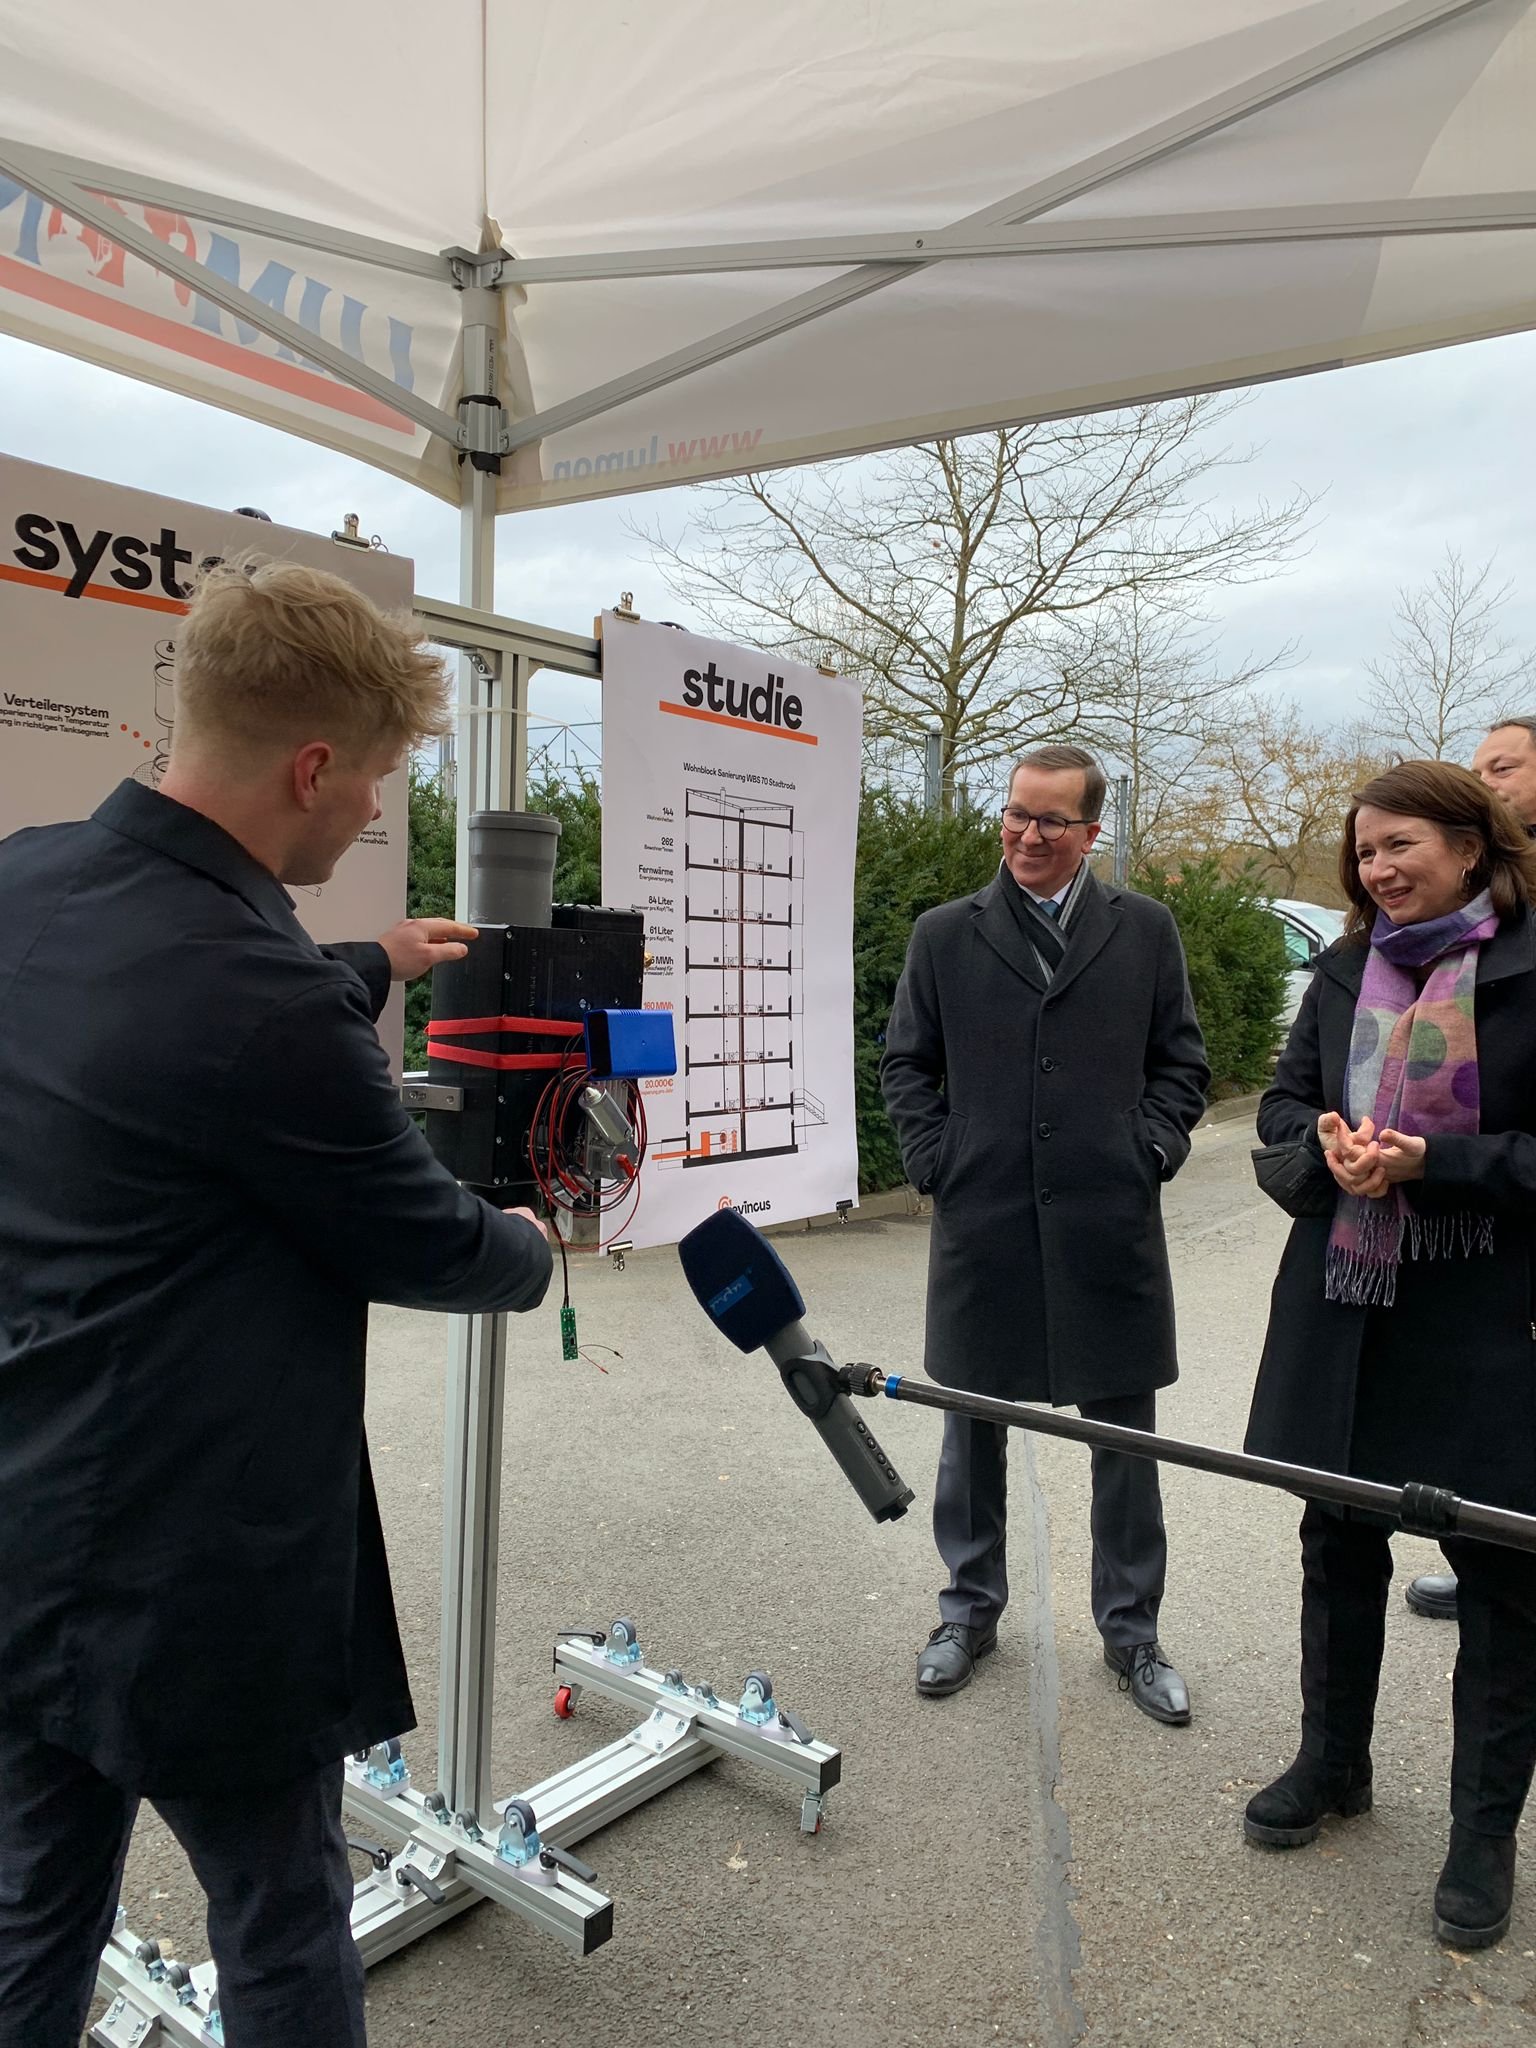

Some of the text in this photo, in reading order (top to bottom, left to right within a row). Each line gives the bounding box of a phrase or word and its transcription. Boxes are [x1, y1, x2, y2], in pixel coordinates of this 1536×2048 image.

[682, 662, 803, 730] studie
[3, 692, 110, 719] Verteilersystem
[44, 713, 63, 722] nach
[64, 715, 110, 728] Temperatur
[14, 718, 21, 726] in
[22, 720, 58, 731] richtiges
[58, 724, 110, 738] Tanksegment
[683, 762, 796, 790] Wohnblock Sanierung WBS 70 Stadtroda
[662, 807, 674, 817] 144
[661, 836, 674, 847] 262
[639, 864, 674, 876] Fernwärme
[648, 895, 674, 906] 84 Liter
[649, 925, 674, 936] 61 Liter
[655, 955, 674, 965] MWh
